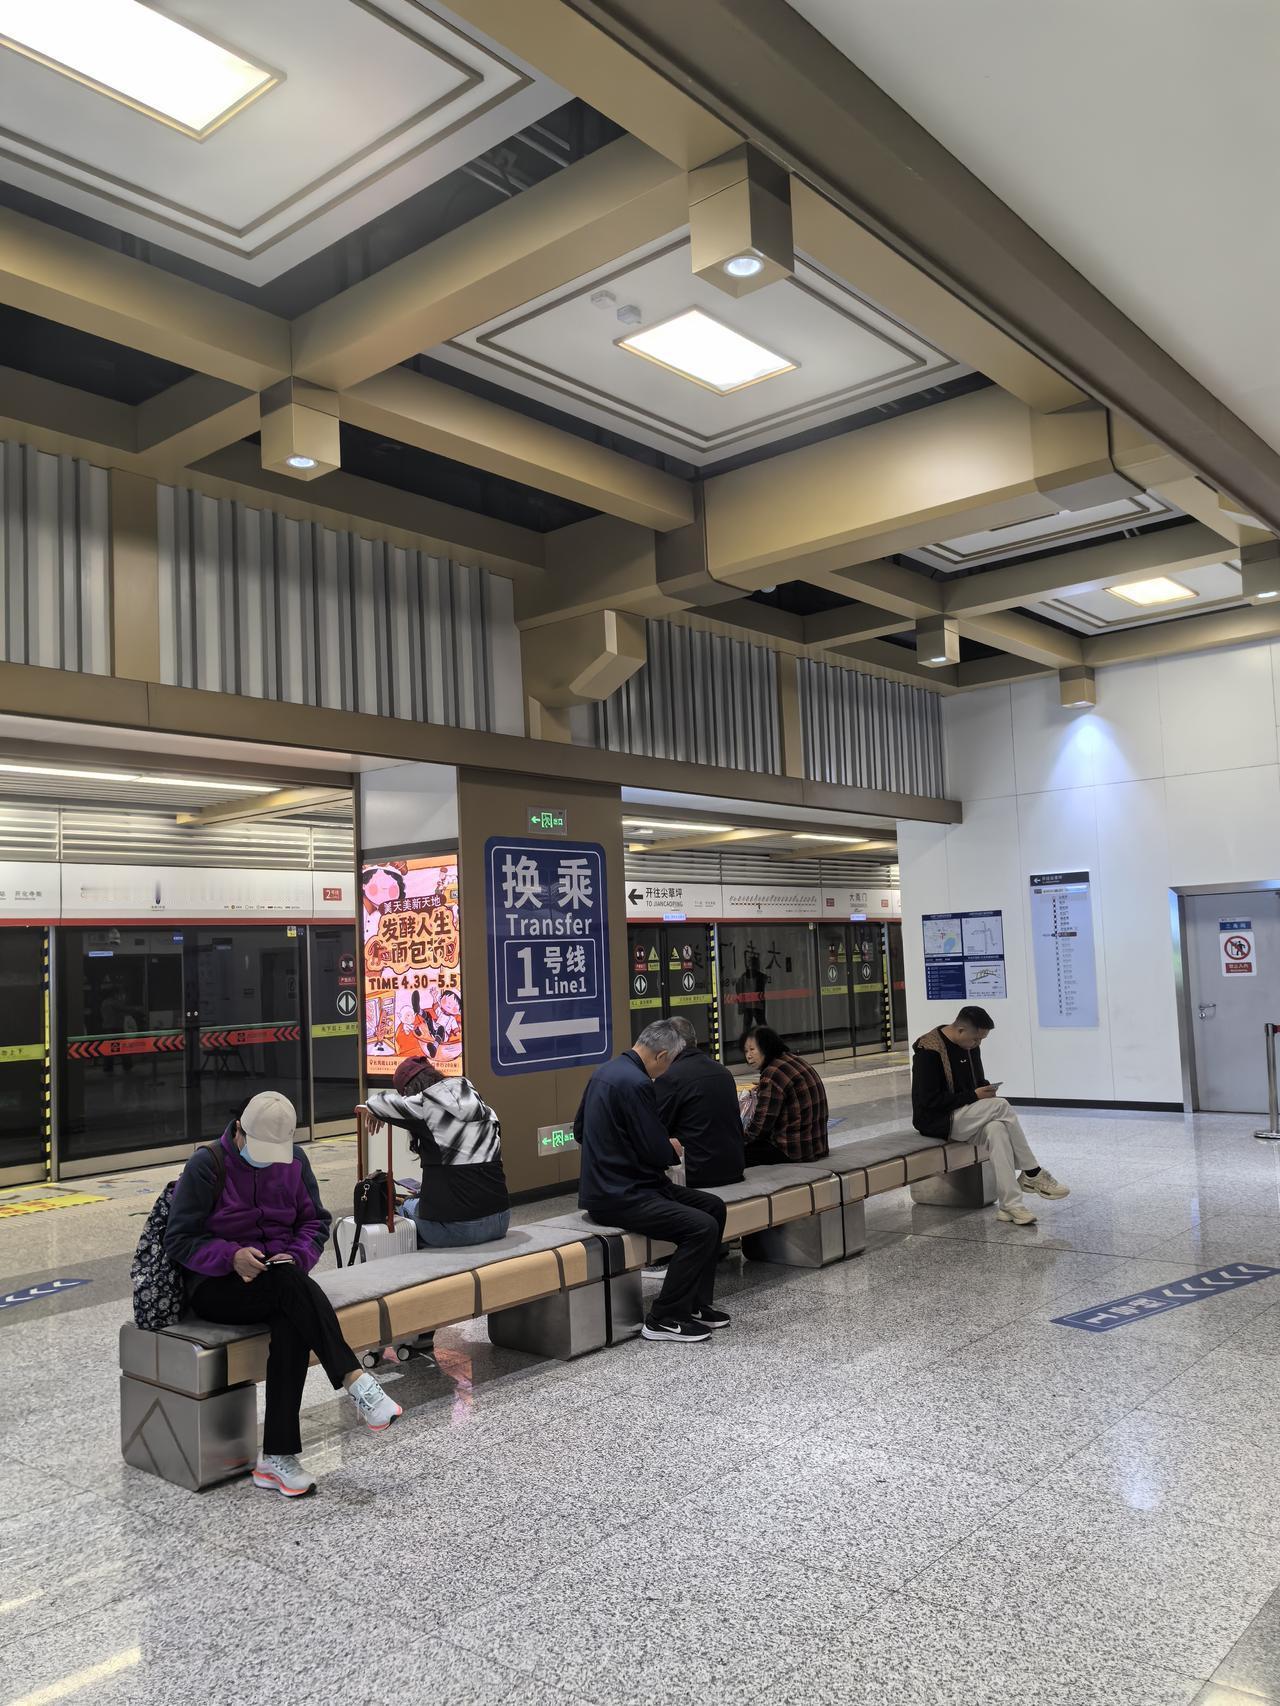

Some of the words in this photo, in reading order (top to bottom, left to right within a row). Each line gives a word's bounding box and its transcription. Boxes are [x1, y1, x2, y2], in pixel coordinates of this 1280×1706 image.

[553, 818, 563, 826] 出口
[502, 854, 594, 909] 换乘
[646, 887, 682, 898] 开往尖草坪
[382, 911, 451, 942] 发酵人生
[505, 913, 593, 937] Transfer
[369, 976, 399, 990] TIME
[545, 976, 587, 995] Line1
